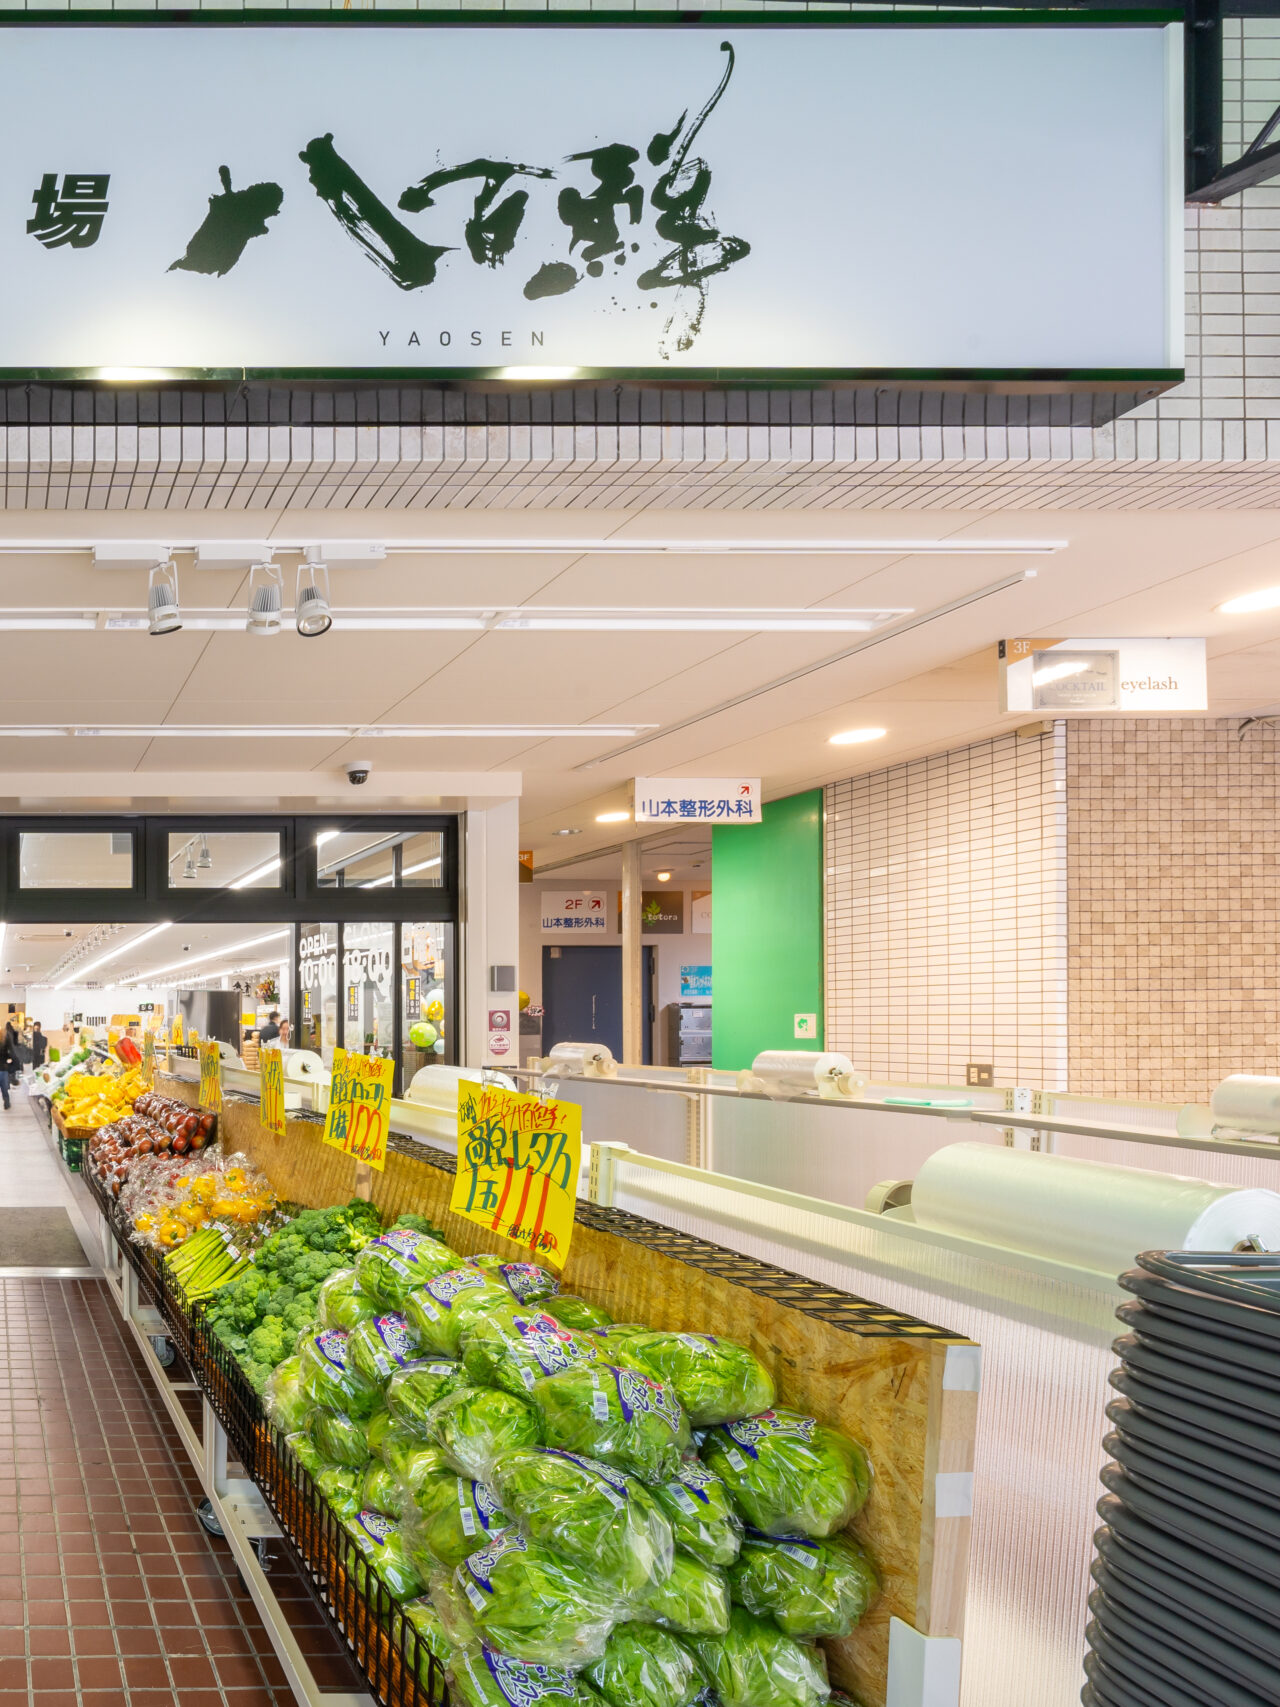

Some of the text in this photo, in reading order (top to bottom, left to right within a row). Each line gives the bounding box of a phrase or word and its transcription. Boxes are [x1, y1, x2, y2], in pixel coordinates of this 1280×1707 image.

[378, 330, 547, 347] YAOSEN
[1014, 642, 1031, 654] 3F
[1121, 677, 1179, 693] eyelash
[642, 799, 753, 818] 山本整形外科
[565, 900, 583, 910] 2F
[542, 917, 605, 928] 山本整形外科
[300, 933, 327, 958] OPEN
